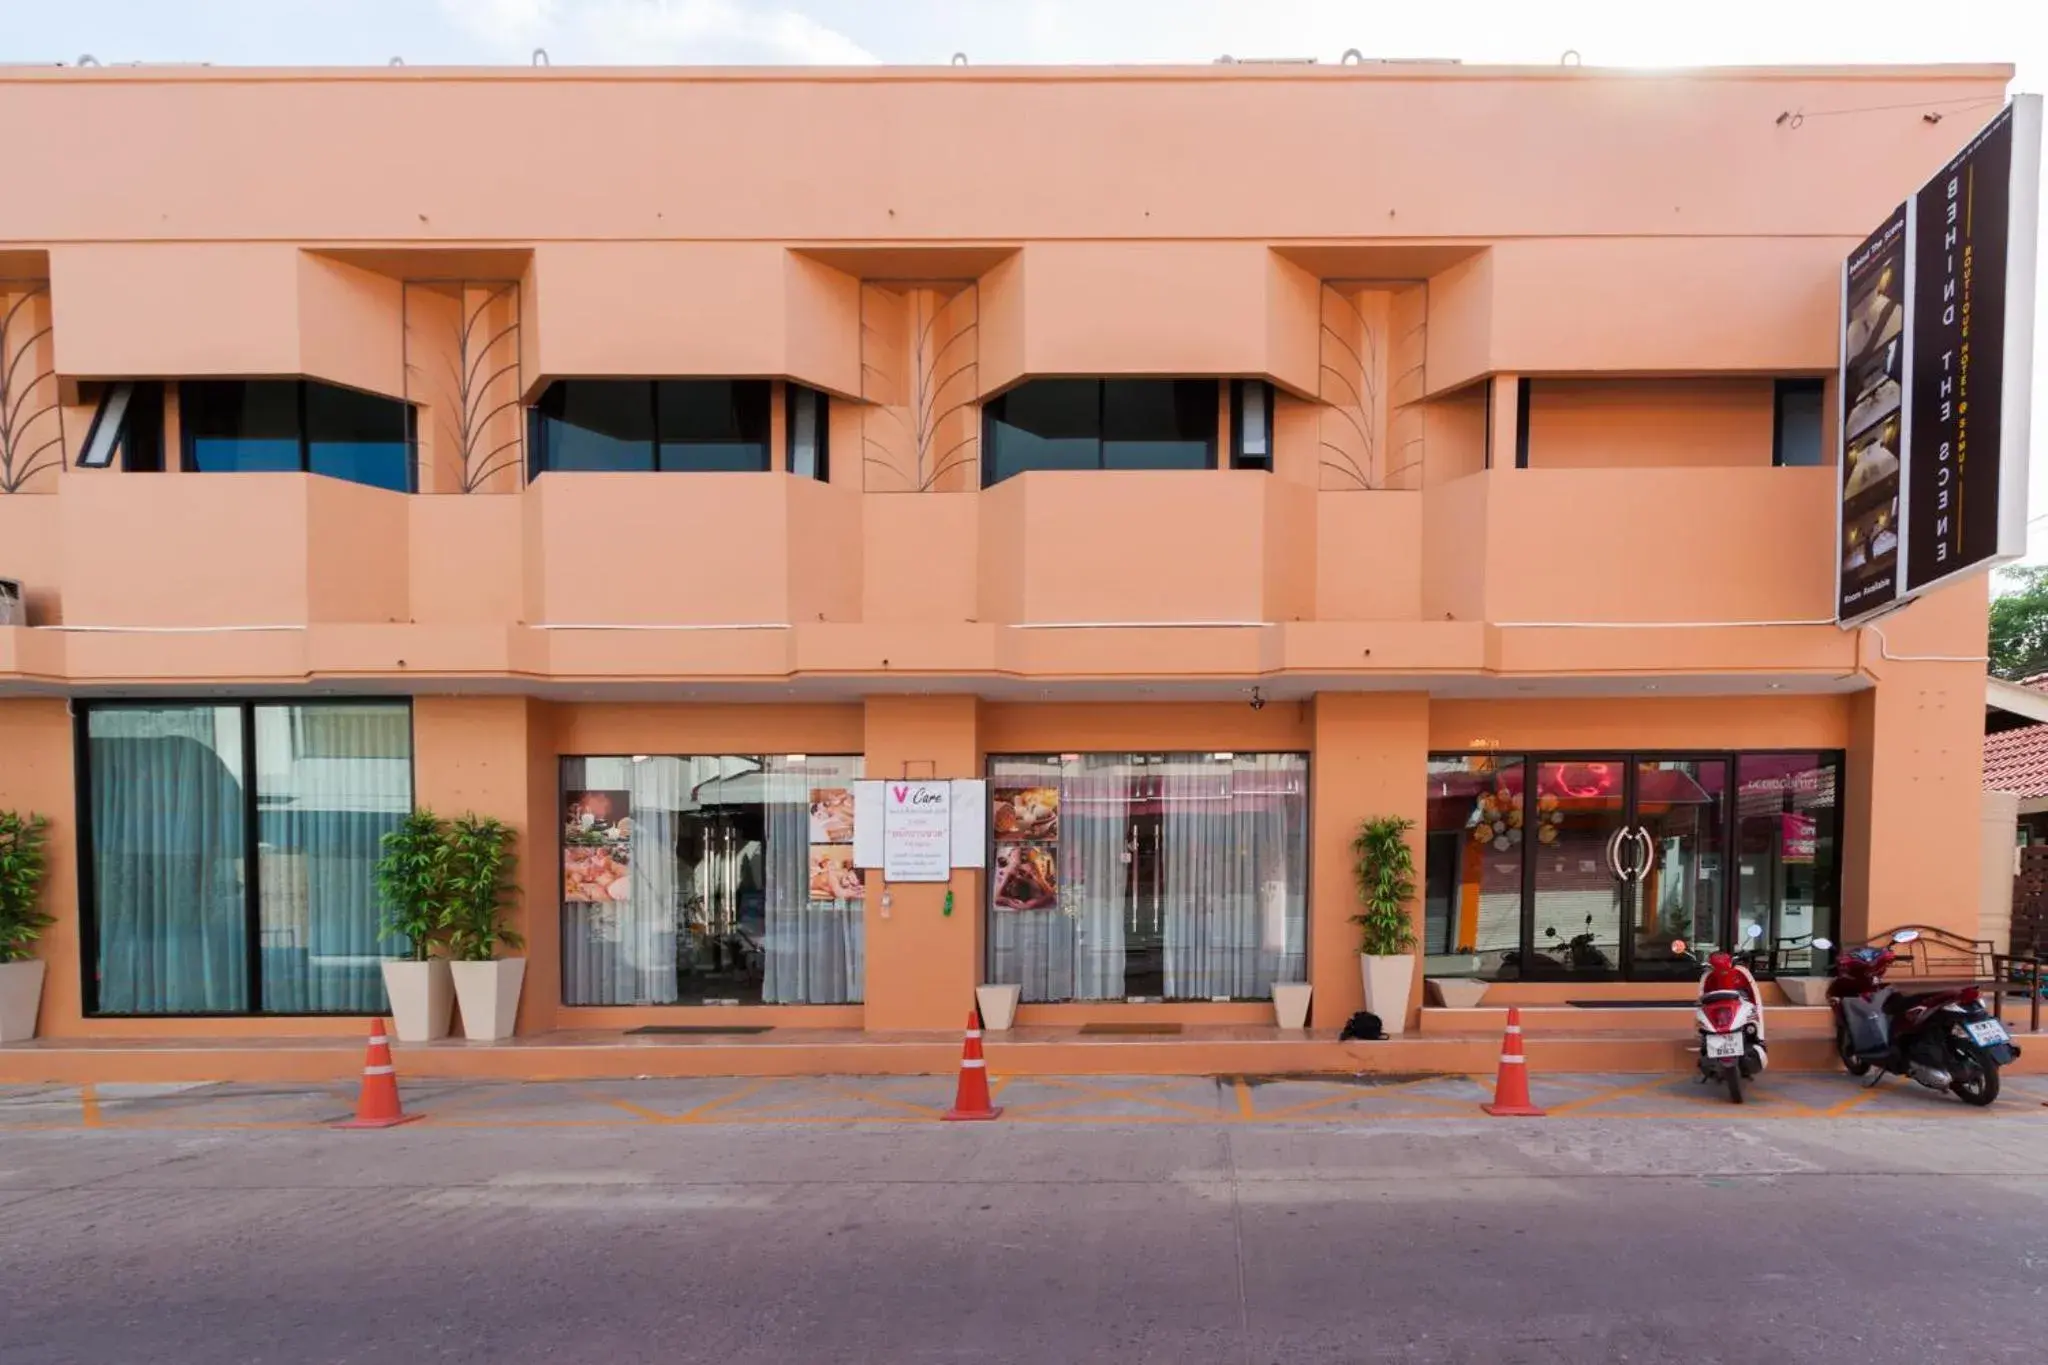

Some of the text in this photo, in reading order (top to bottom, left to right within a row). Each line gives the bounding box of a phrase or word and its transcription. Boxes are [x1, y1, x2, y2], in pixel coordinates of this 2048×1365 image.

[1960, 341, 1969, 397] HOTEL
[893, 785, 942, 805] V Care
